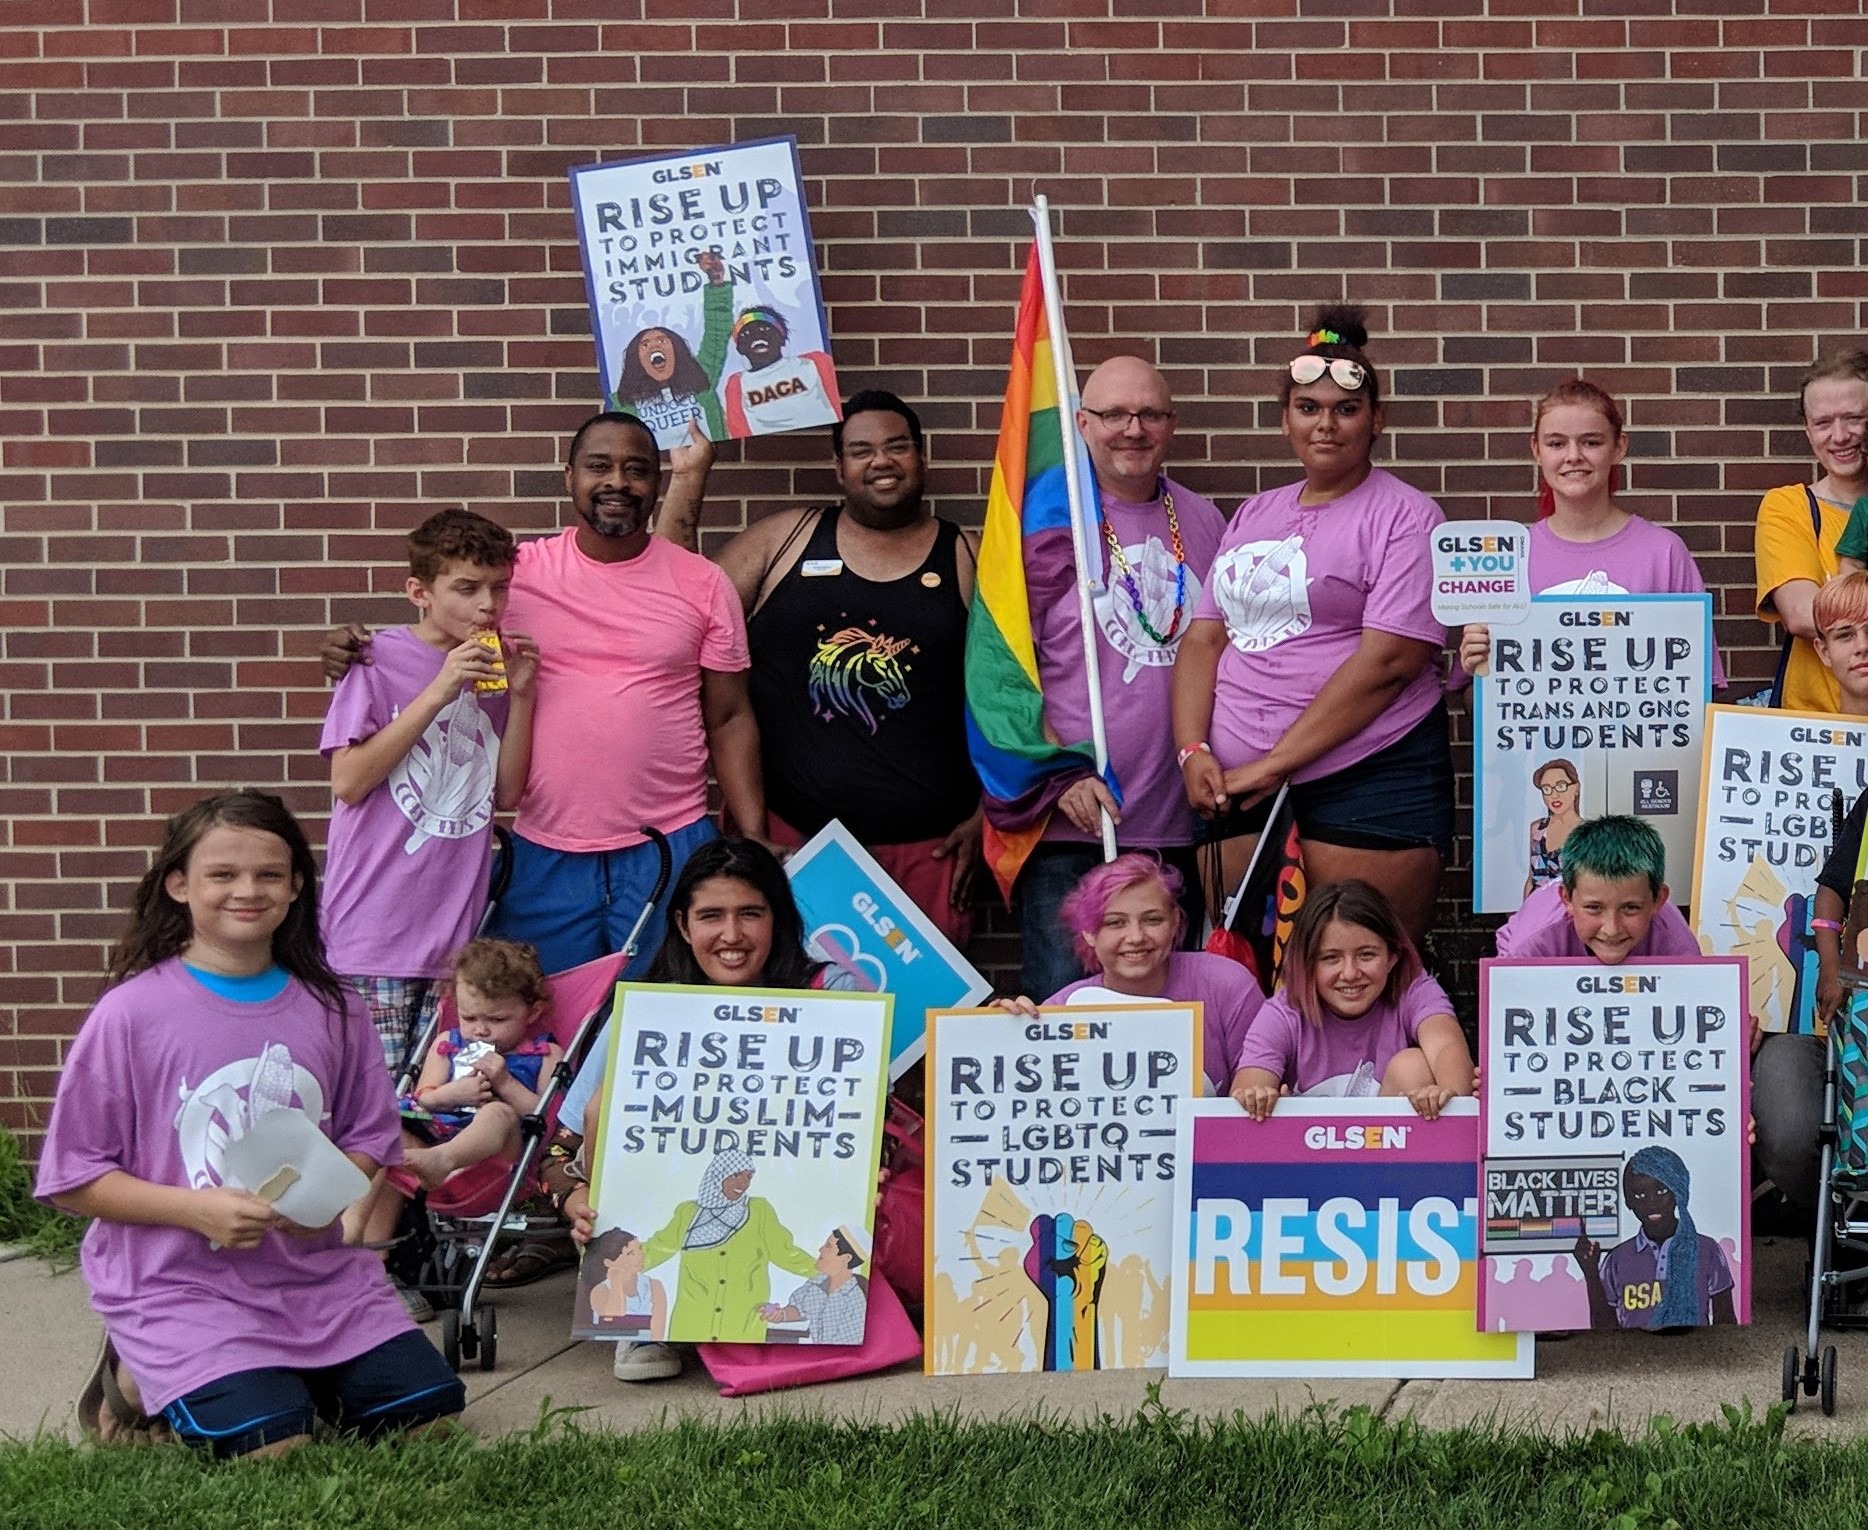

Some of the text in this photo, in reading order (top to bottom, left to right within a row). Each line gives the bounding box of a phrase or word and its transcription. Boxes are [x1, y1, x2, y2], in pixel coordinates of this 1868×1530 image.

[652, 162, 722, 184] GLSEN
[595, 178, 782, 233] RISE UP
[599, 212, 787, 254] TO PROTECT
[605, 233, 791, 278] IMMIGRANT
[609, 256, 797, 304] STUDNTS
[747, 376, 808, 407] DACA
[644, 407, 703, 432] QUEER
[1438, 536, 1514, 553] GLSEN
[1439, 580, 1515, 593] CHANGE
[1559, 611, 1631, 627] GLSEN
[1495, 637, 1692, 673] RISE UP
[1495, 676, 1692, 695] TO PROTECT
[1497, 700, 1690, 720] TRANS AND GNC
[1496, 723, 1691, 751] STUDENTS
[1790, 727, 1862, 746] GLSEN
[1723, 748, 1837, 789] RISE
[1722, 786, 1857, 812] TO PROT
[1764, 812, 1833, 838] LGB
[852, 891, 920, 965] GLSEN
[1576, 976, 1656, 994] GLSEN
[713, 1005, 798, 1024] GLSEN
[1504, 1005, 1726, 1046] RISE UP
[1025, 1022, 1107, 1041] GLSEN
[633, 1030, 864, 1072] RISE UP
[1504, 1049, 1726, 1073] TO PROTECT
[631, 1071, 861, 1096] TO PROTECT
[950, 1051, 1178, 1095] RISE UP
[1554, 1076, 1676, 1105] BLACK
[651, 1094, 835, 1128] MUSLIM
[951, 1094, 1178, 1121] TO PROTECT
[1002, 1122, 1128, 1153] LGBTQ
[1304, 1126, 1406, 1150] GLSEN
[1504, 1108, 1726, 1140] STUDENTS
[623, 1125, 855, 1158] STUDENTS
[951, 1152, 1175, 1188] STUDENTS
[1488, 1169, 1618, 1191] BLACK LIVES
[1487, 1189, 1618, 1219] MATTER
[1623, 1281, 1662, 1311] GSA
